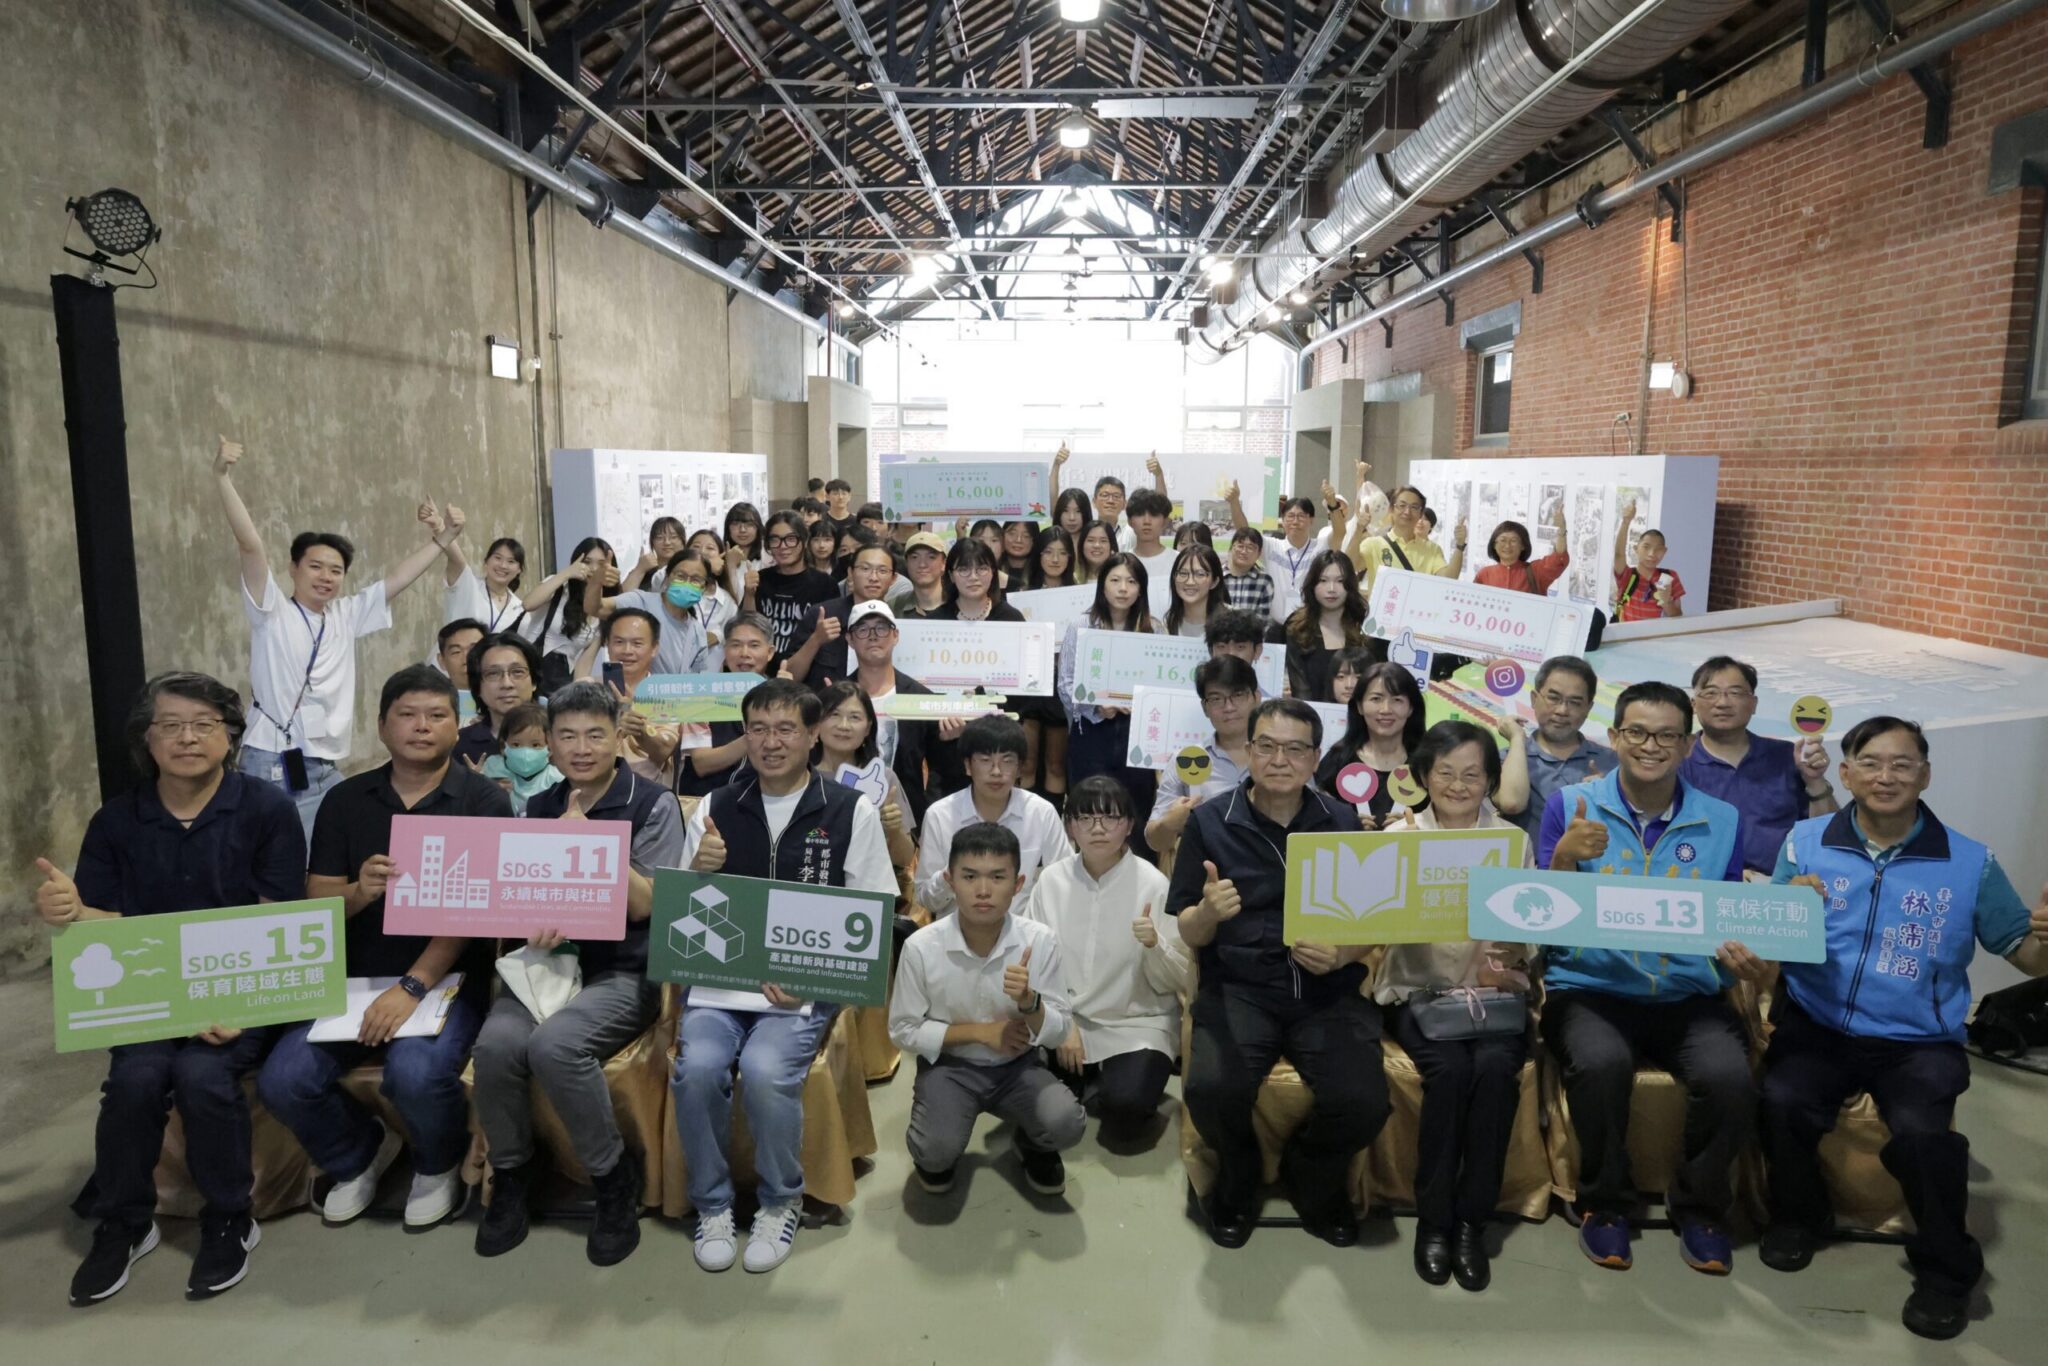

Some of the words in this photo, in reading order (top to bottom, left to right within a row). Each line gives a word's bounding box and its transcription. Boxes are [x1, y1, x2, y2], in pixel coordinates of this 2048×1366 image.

[947, 486, 1004, 499] 16,000
[1383, 585, 1400, 615] 金獎
[1449, 609, 1526, 638] 30,000
[928, 649, 999, 667] 10,000
[1156, 665, 1197, 684] 16,0
[1147, 707, 1161, 742] 金獎
[502, 862, 552, 878] SDGS
[563, 846, 612, 880] 11
[797, 865, 815, 882] 李
[1423, 866, 1469, 881] SDGS
[501, 886, 612, 903] 永續城市與社區
[1603, 910, 1645, 925] SDGS
[1655, 899, 1698, 928] 13
[1716, 896, 1808, 923] 氣候行動
[771, 925, 831, 949] SDGS
[843, 912, 873, 953] 9
[1716, 921, 1765, 936] Climate
[1768, 925, 1808, 938] Action
[1927, 887, 1952, 957] 臺中市議員
[188, 951, 252, 974] SDGS
[266, 923, 326, 964] 15
[768, 963, 805, 975] Innovation
[806, 968, 820, 976] and
[821, 969, 868, 981] Infrastructure
[769, 952, 869, 972] 產業創新與基礎建設
[188, 967, 325, 1000] 保育陸域生態
[247, 994, 270, 1007] Life
[273, 995, 290, 1003] on
[294, 987, 325, 1001] Land
